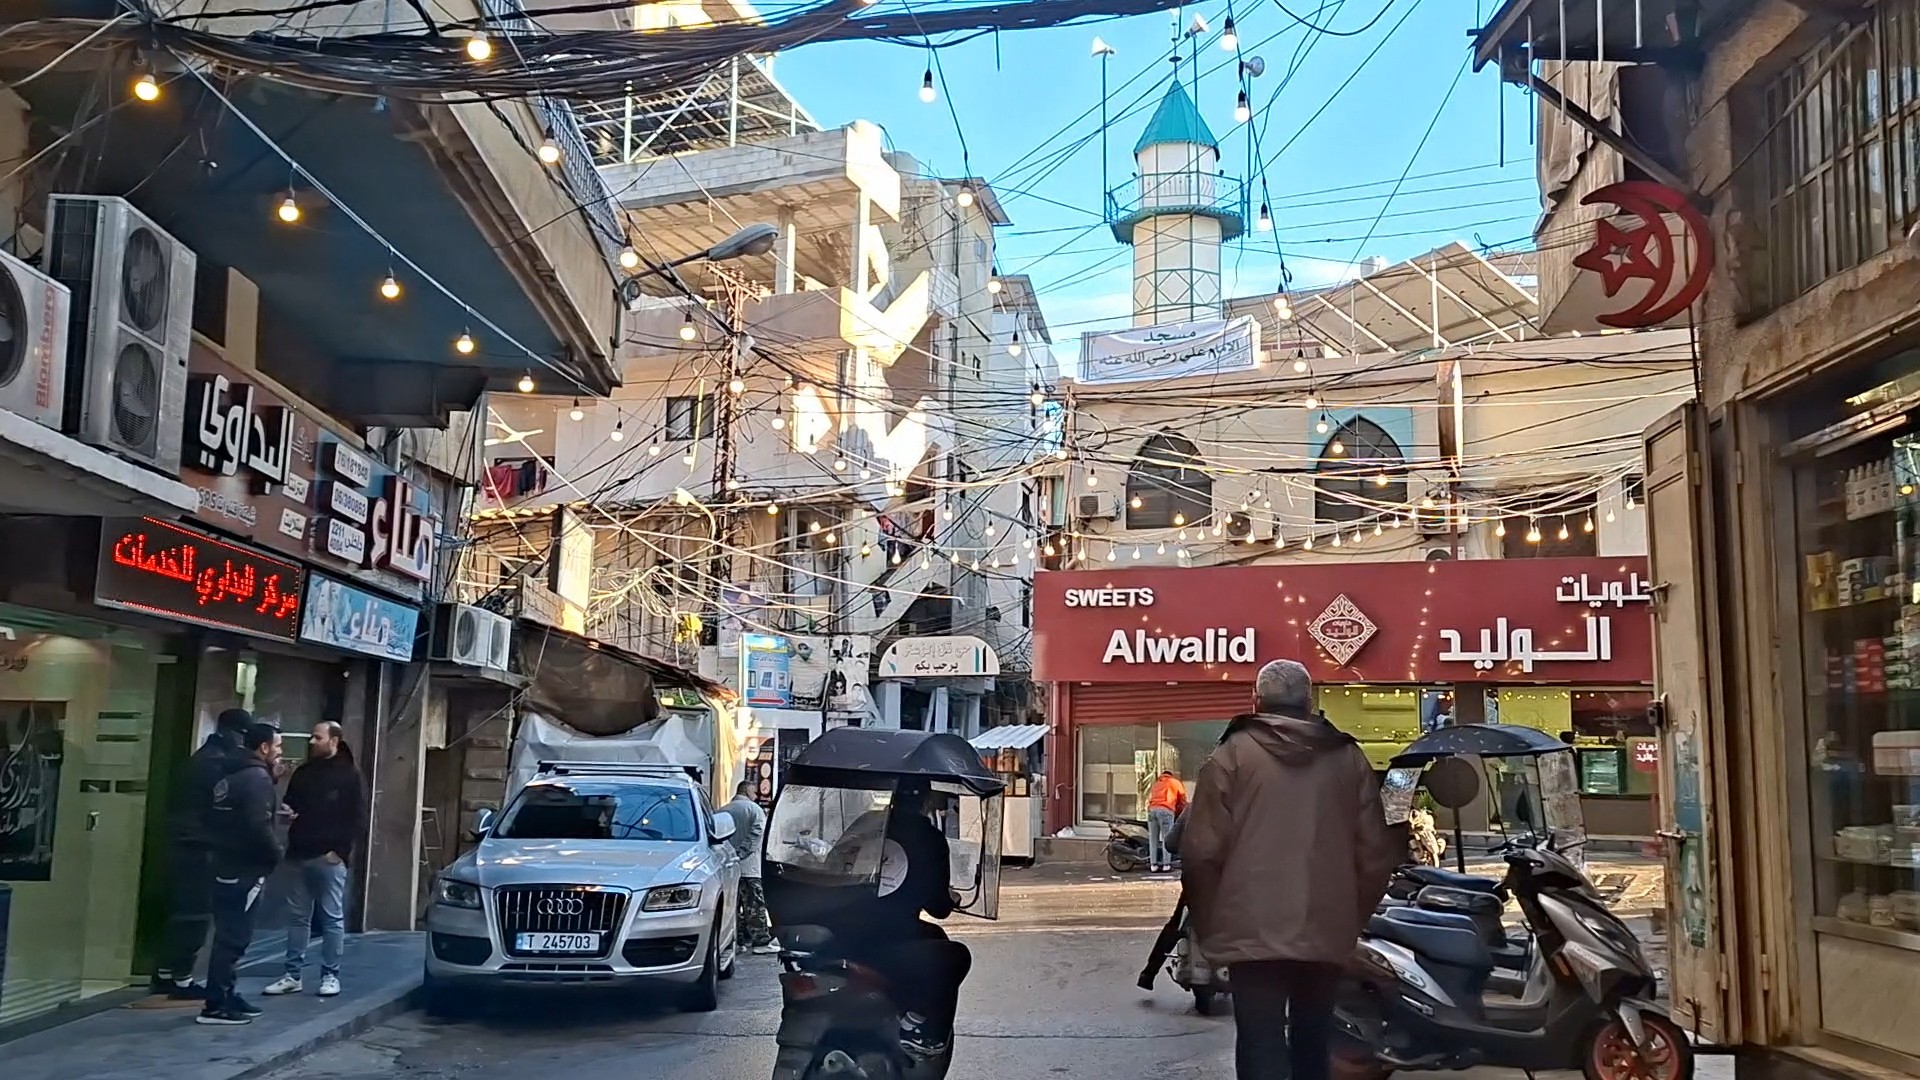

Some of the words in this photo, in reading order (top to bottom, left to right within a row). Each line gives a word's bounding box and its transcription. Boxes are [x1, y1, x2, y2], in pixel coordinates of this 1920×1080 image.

[1143, 330, 1196, 346] مسجد
[1125, 350, 1145, 364] الله
[199, 373, 294, 495] البداوي
[255, 574, 298, 619] مركز
[1065, 587, 1154, 608] SWEETS
[1102, 627, 1256, 664] Alwalid
[1439, 616, 1611, 673] الوليد
[914, 660, 930, 674] بكم
[933, 661, 959, 673] يرحب
[527, 934, 535, 949] T
[543, 935, 591, 949] 245703
